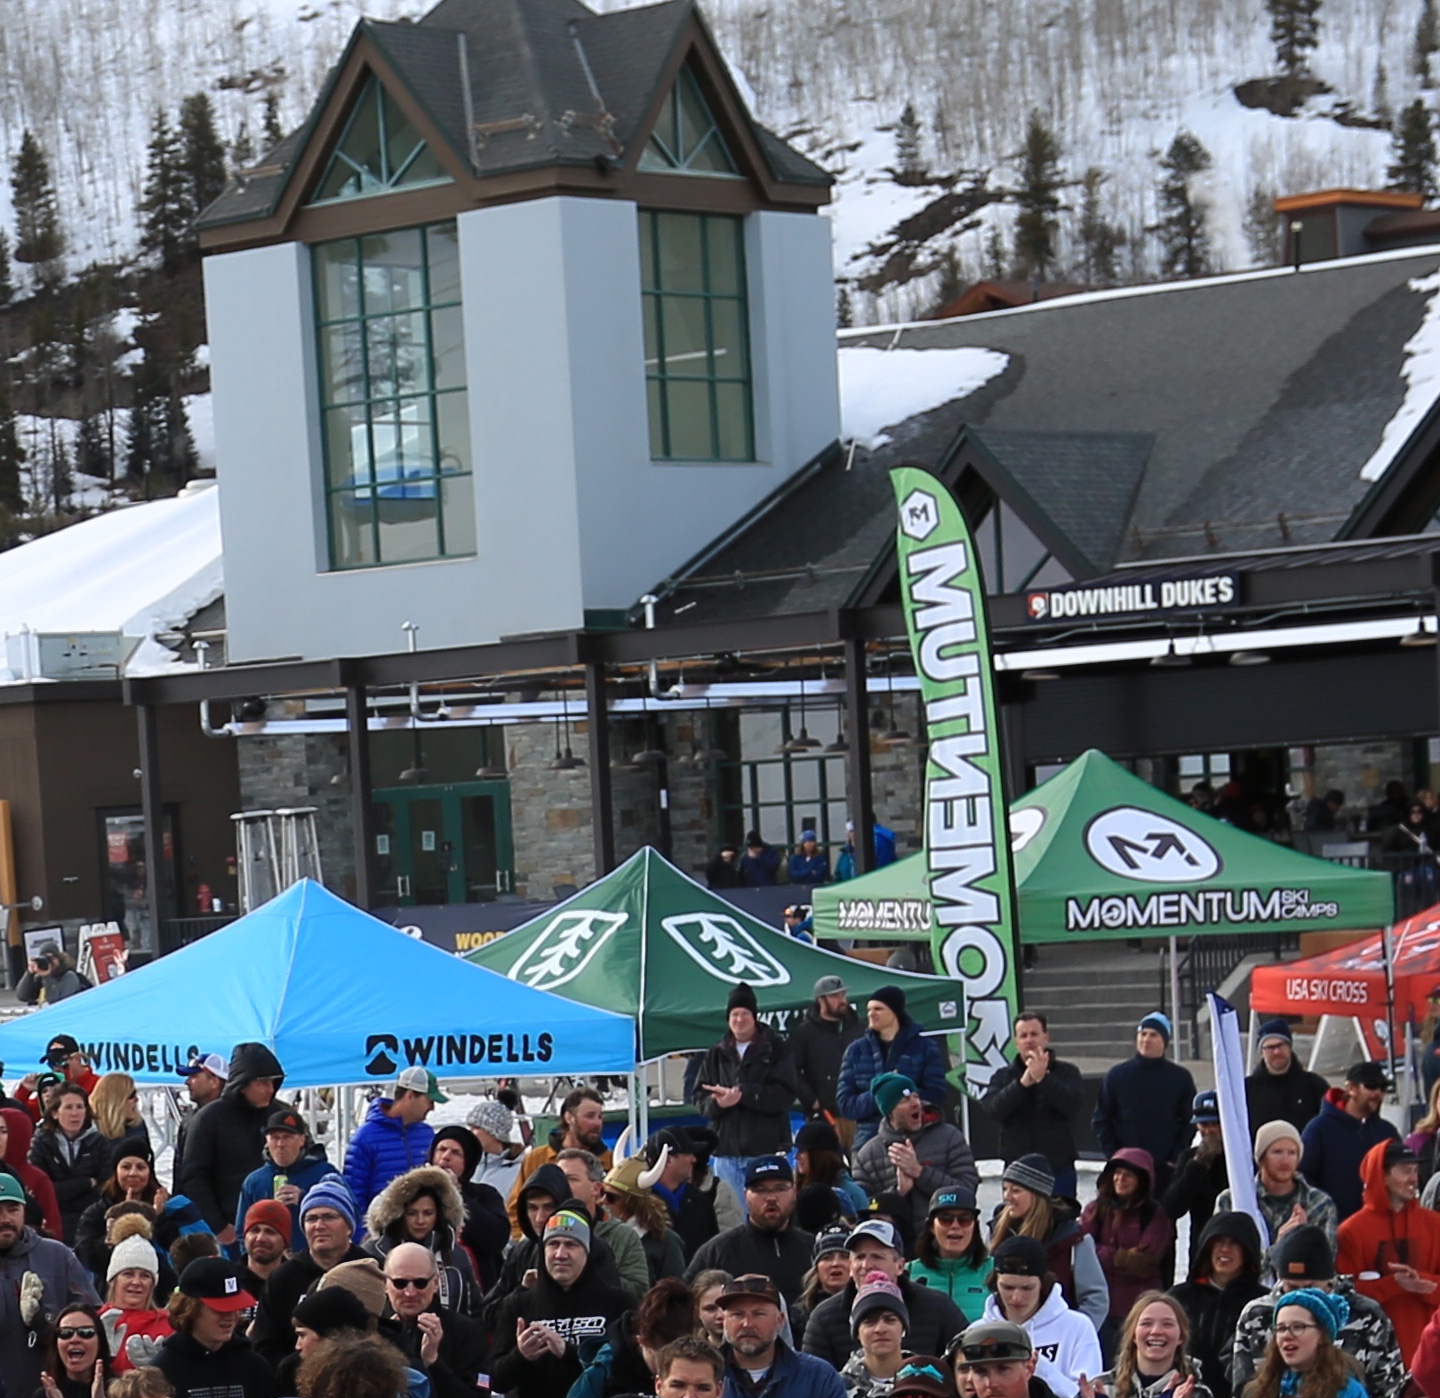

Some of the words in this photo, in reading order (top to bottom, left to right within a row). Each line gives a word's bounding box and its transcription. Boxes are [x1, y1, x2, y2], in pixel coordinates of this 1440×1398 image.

[1050, 582, 1156, 618] DOWNHILL
[1161, 575, 1234, 608] DUKE'S
[1068, 889, 1280, 930] MOMENTUM
[1282, 887, 1310, 904] SKI
[1282, 901, 1340, 919] CAMPS
[838, 899, 932, 931] MOMENTU
[1285, 978, 1308, 1000] USA
[1309, 980, 1326, 1001] SKI
[1327, 981, 1366, 1003] CROSS
[402, 1033, 554, 1066] WINDELLS
